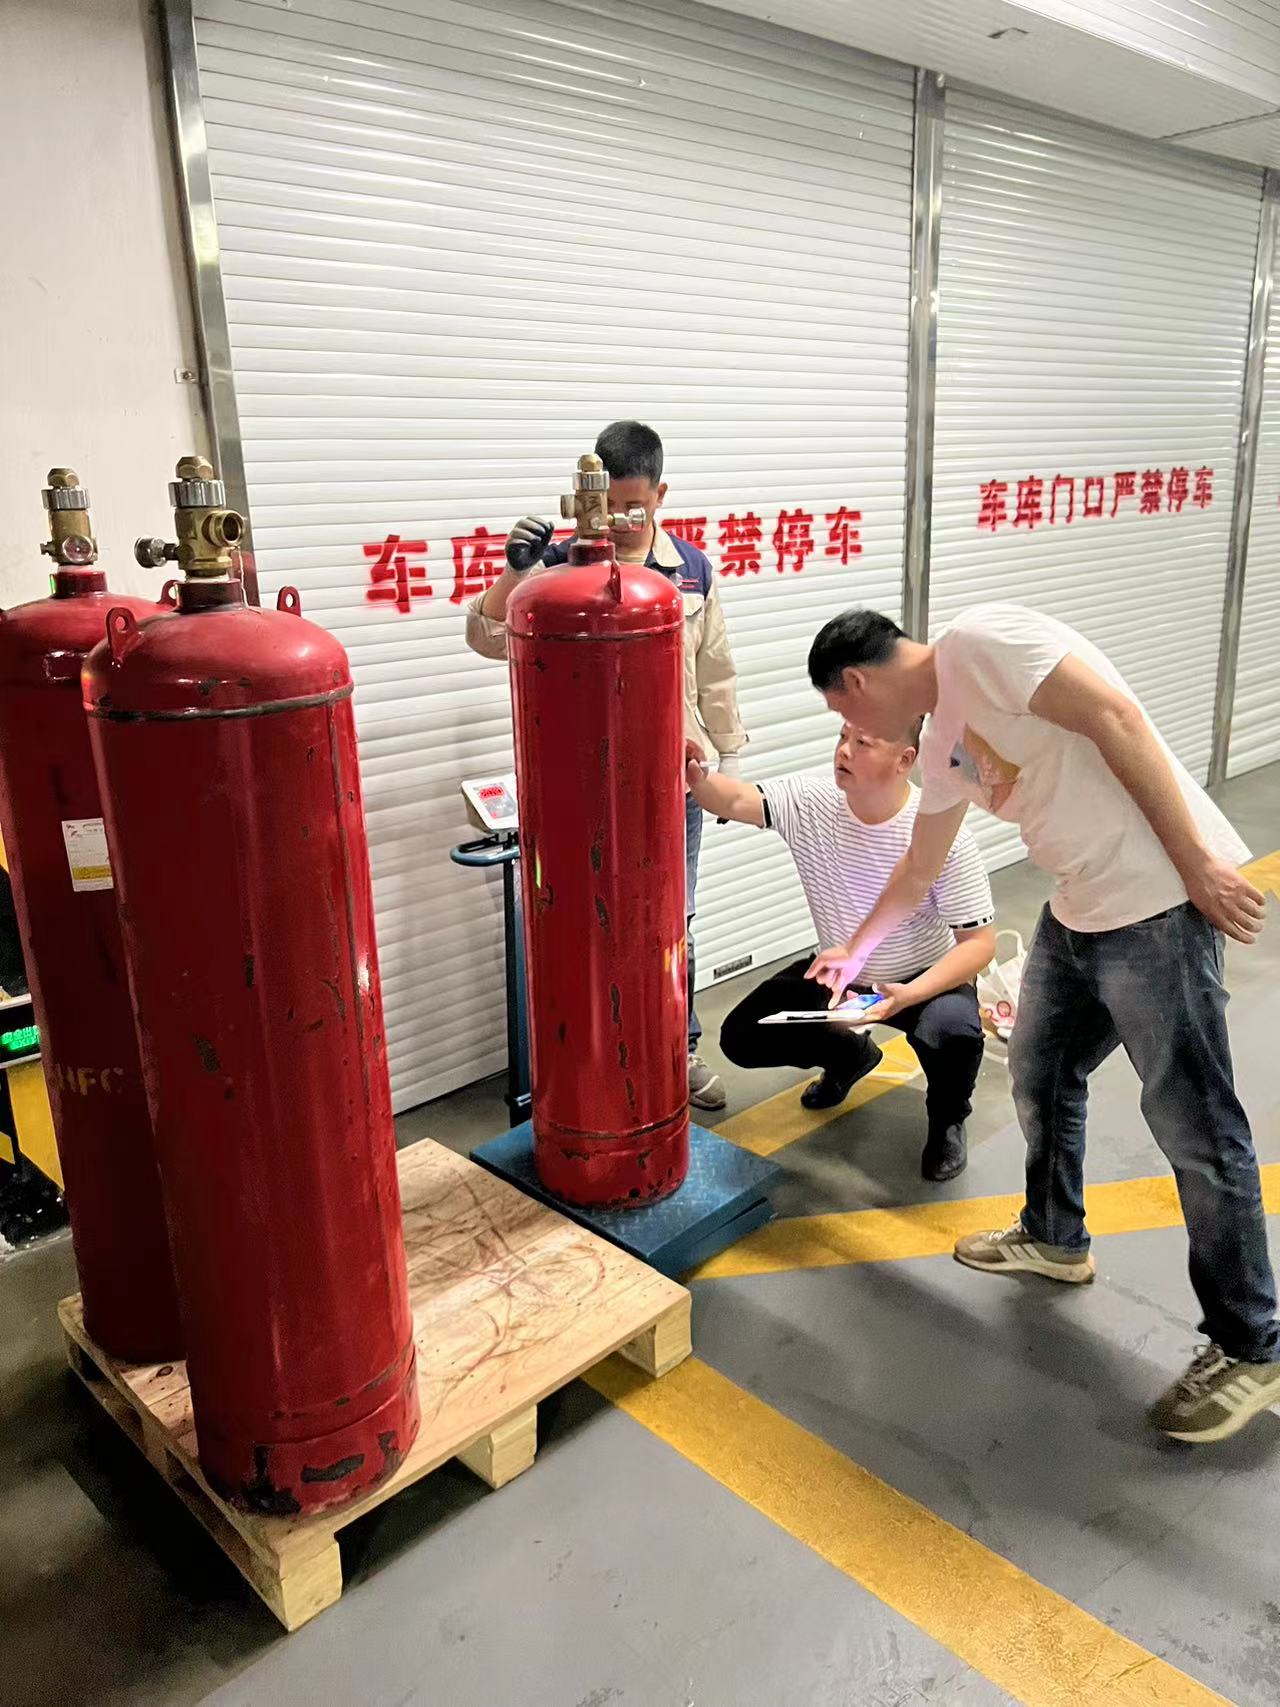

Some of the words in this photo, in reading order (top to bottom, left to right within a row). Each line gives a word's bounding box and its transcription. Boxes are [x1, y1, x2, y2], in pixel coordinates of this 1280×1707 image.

[978, 466, 1213, 531] 车库门口严禁停车
